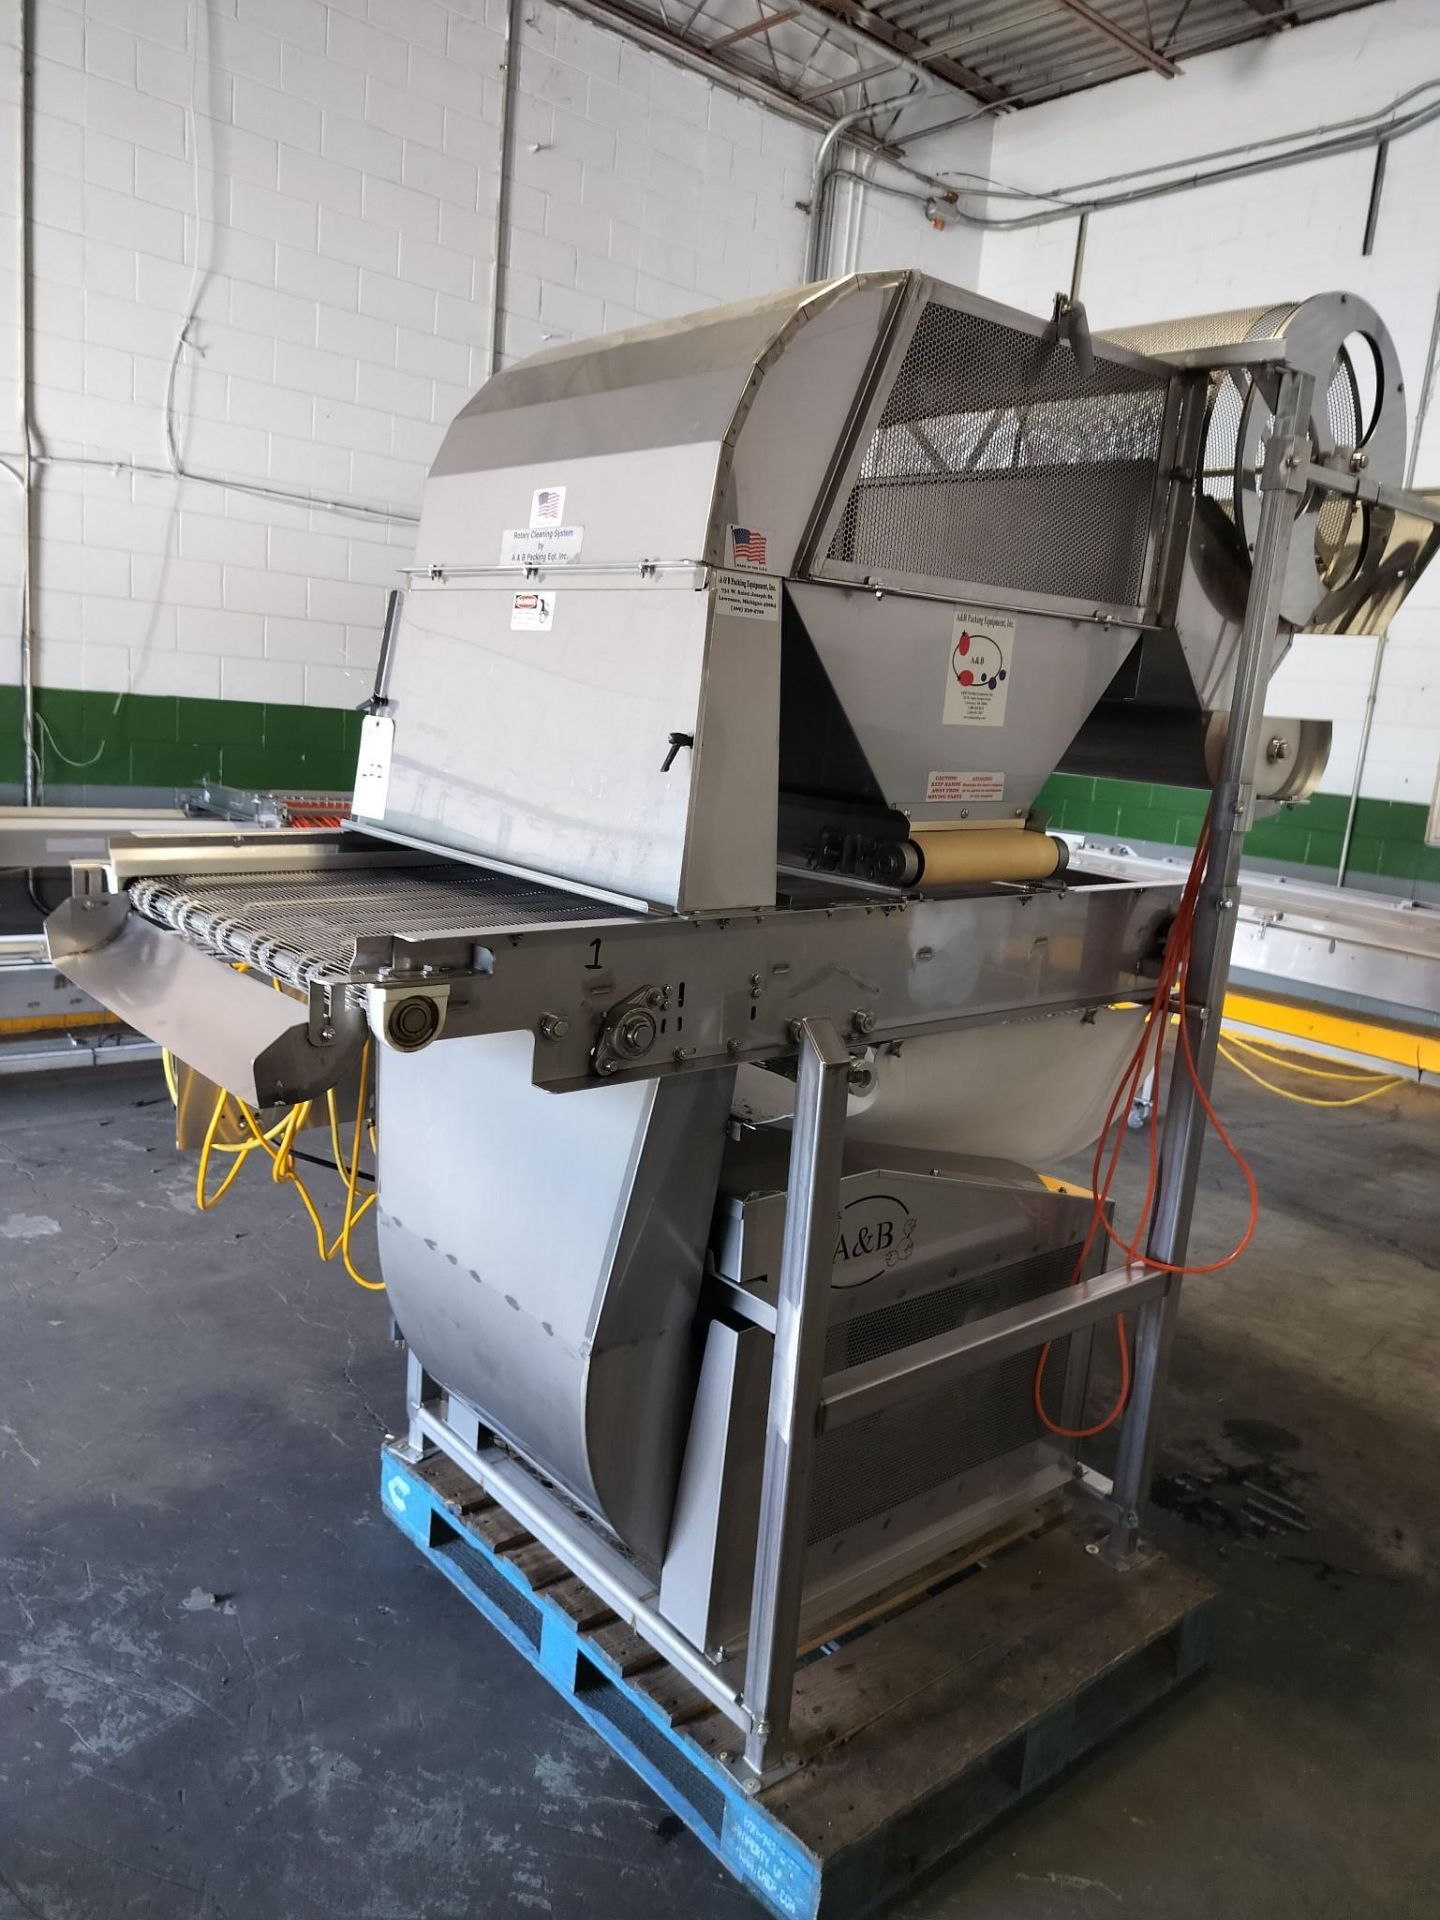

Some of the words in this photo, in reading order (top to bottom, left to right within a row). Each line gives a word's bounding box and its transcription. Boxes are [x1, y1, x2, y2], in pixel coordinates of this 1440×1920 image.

[514, 531, 529, 540] Rotary
[531, 529, 552, 540] Cleaning
[553, 528, 574, 540] System
[537, 542, 545, 551] by
[526, 552, 547, 562] Packing
[731, 577, 747, 589] Packing
[742, 598, 763, 607] Michigan
[968, 614, 984, 627] Packing
[584, 938, 603, 970] 1
[832, 1221, 894, 1265] A&B
